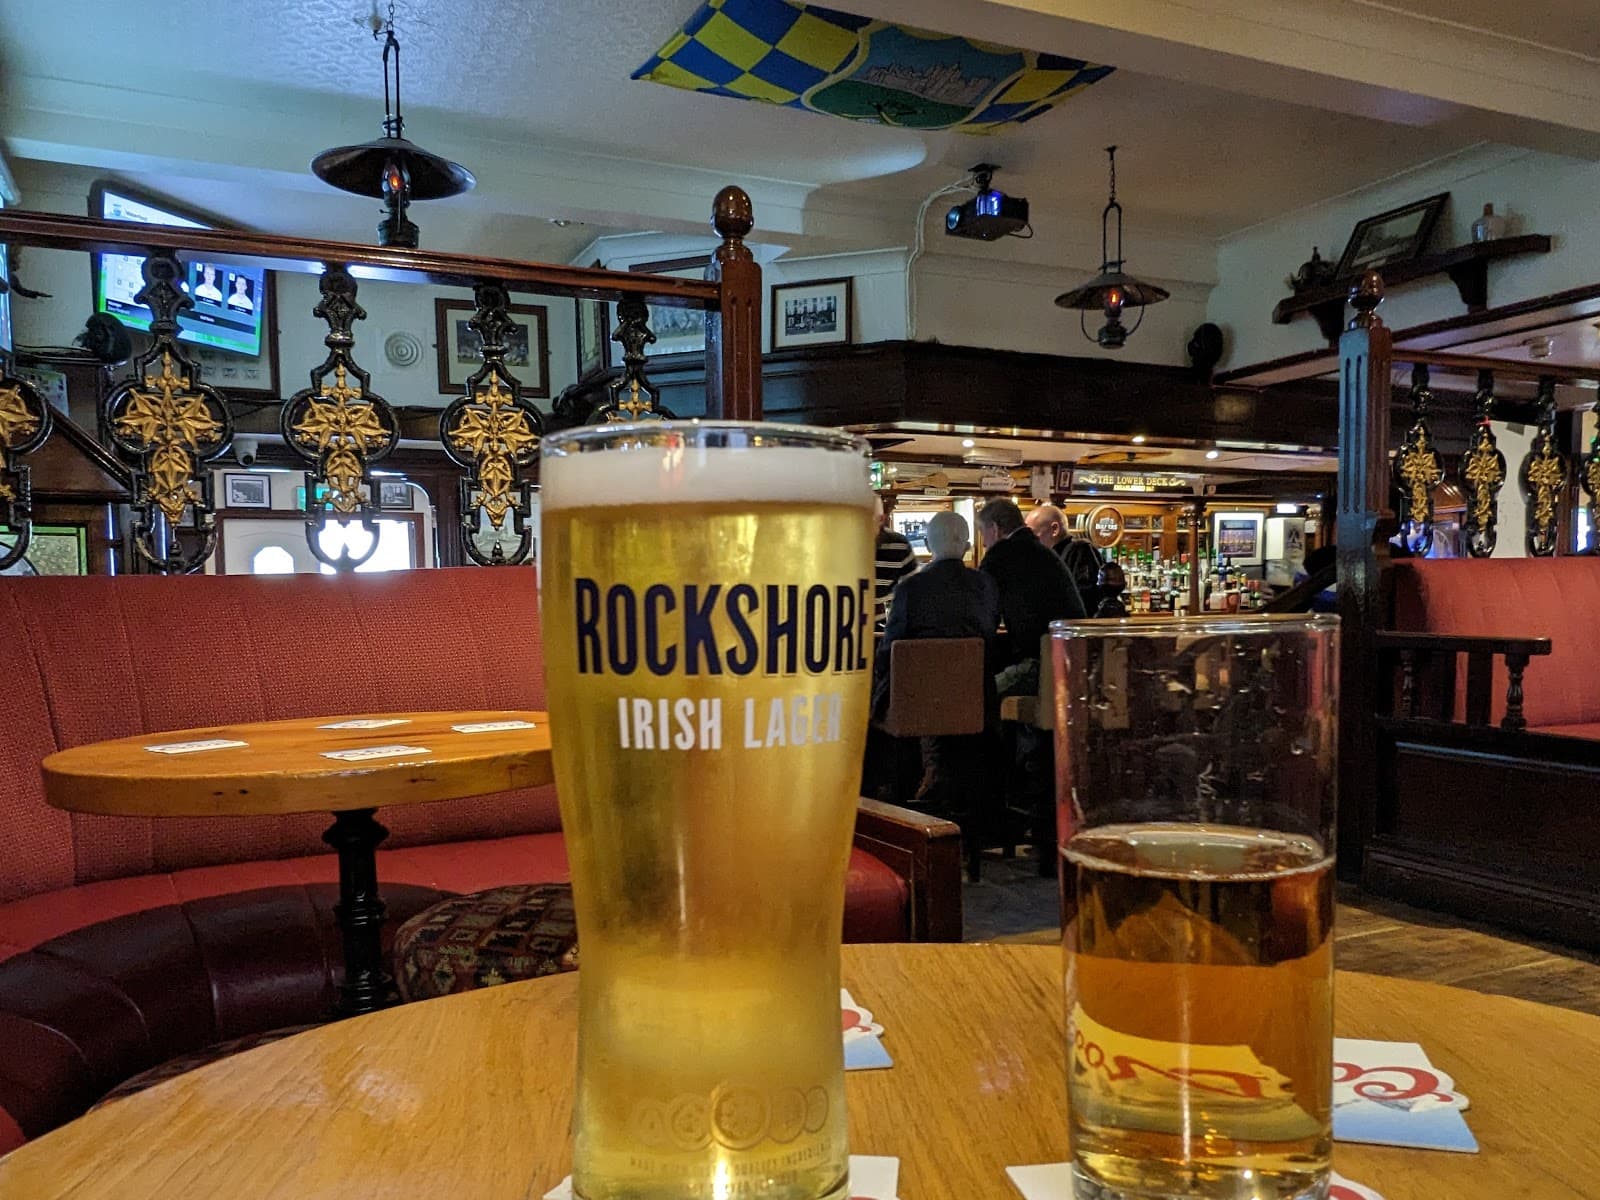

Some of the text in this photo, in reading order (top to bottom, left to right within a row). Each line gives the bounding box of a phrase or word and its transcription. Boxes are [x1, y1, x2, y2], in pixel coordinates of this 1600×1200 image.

[1098, 475, 1169, 486] THE LOWER DECK
[575, 578, 869, 676] ROCKSHORE
[618, 694, 842, 750] IRISH LAGER
